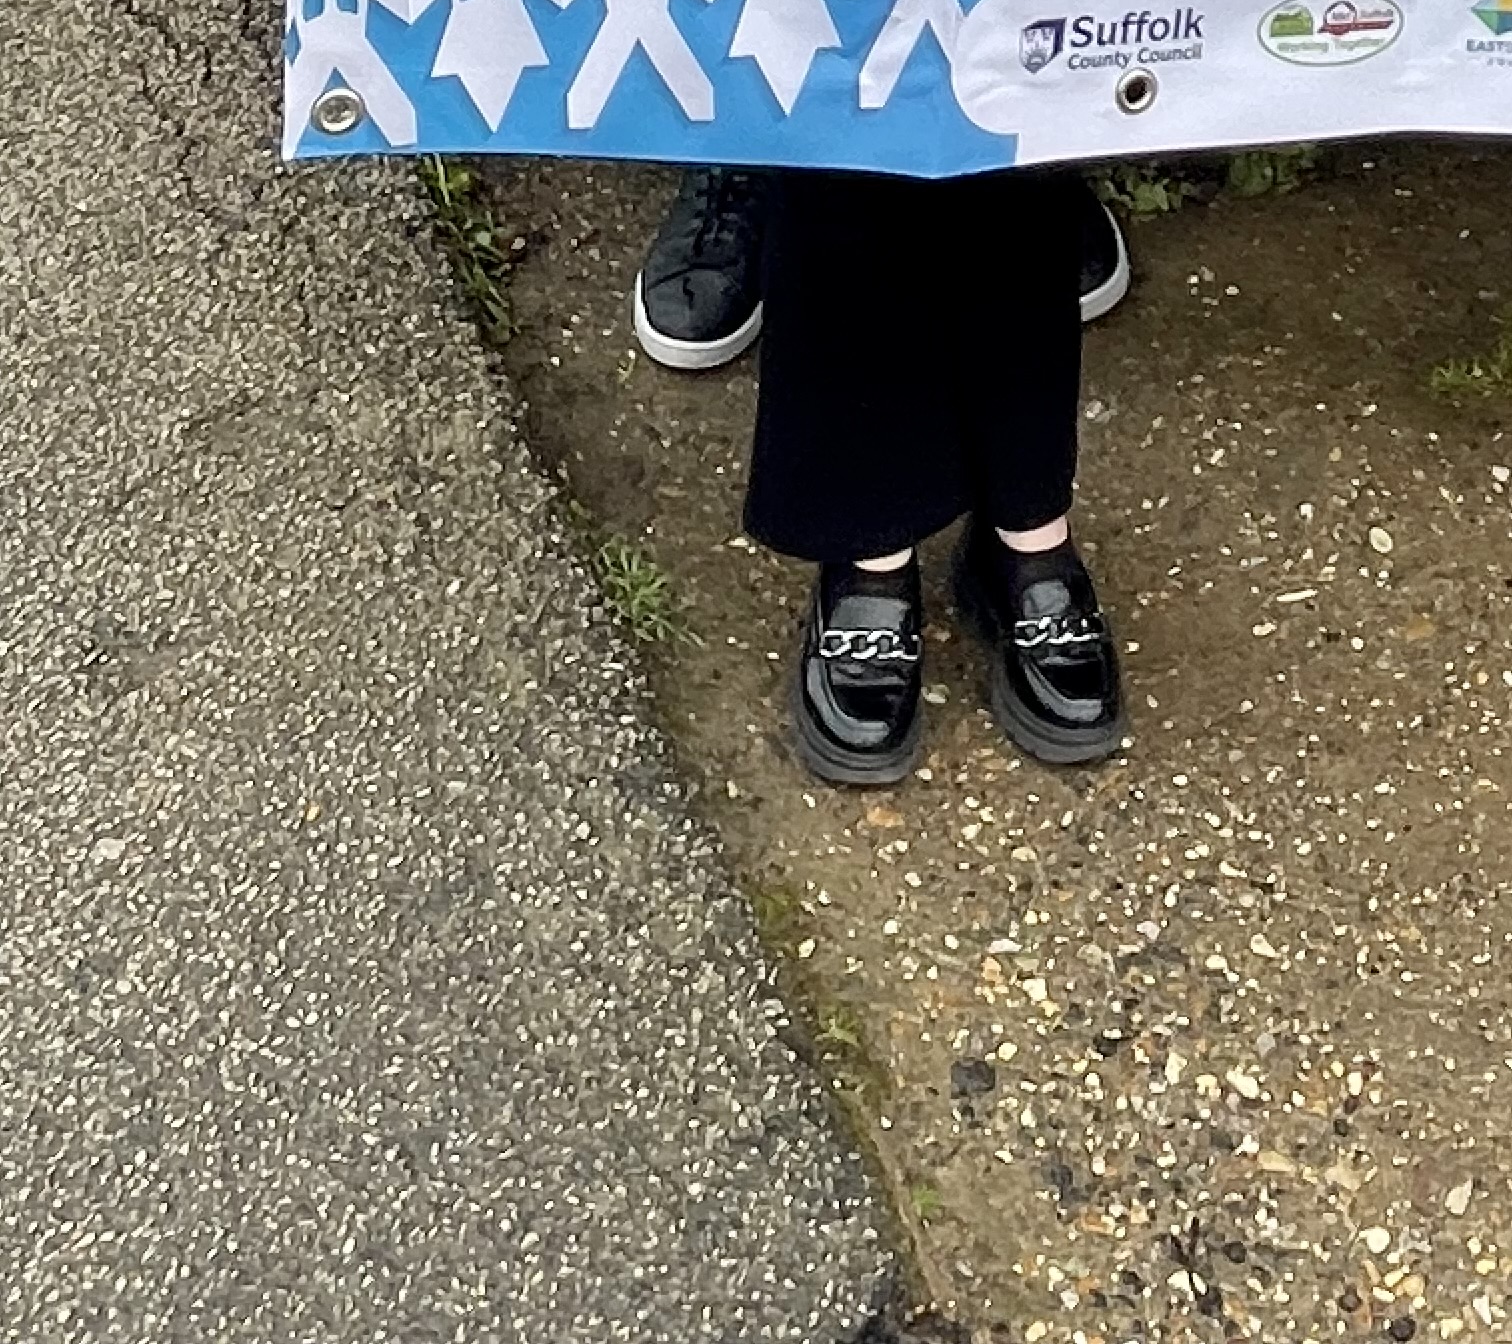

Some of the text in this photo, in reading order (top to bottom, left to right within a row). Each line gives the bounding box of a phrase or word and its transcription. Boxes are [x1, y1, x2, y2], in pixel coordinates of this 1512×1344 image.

[1070, 7, 1205, 48] Suffolk
[1068, 43, 1203, 70] County Council
